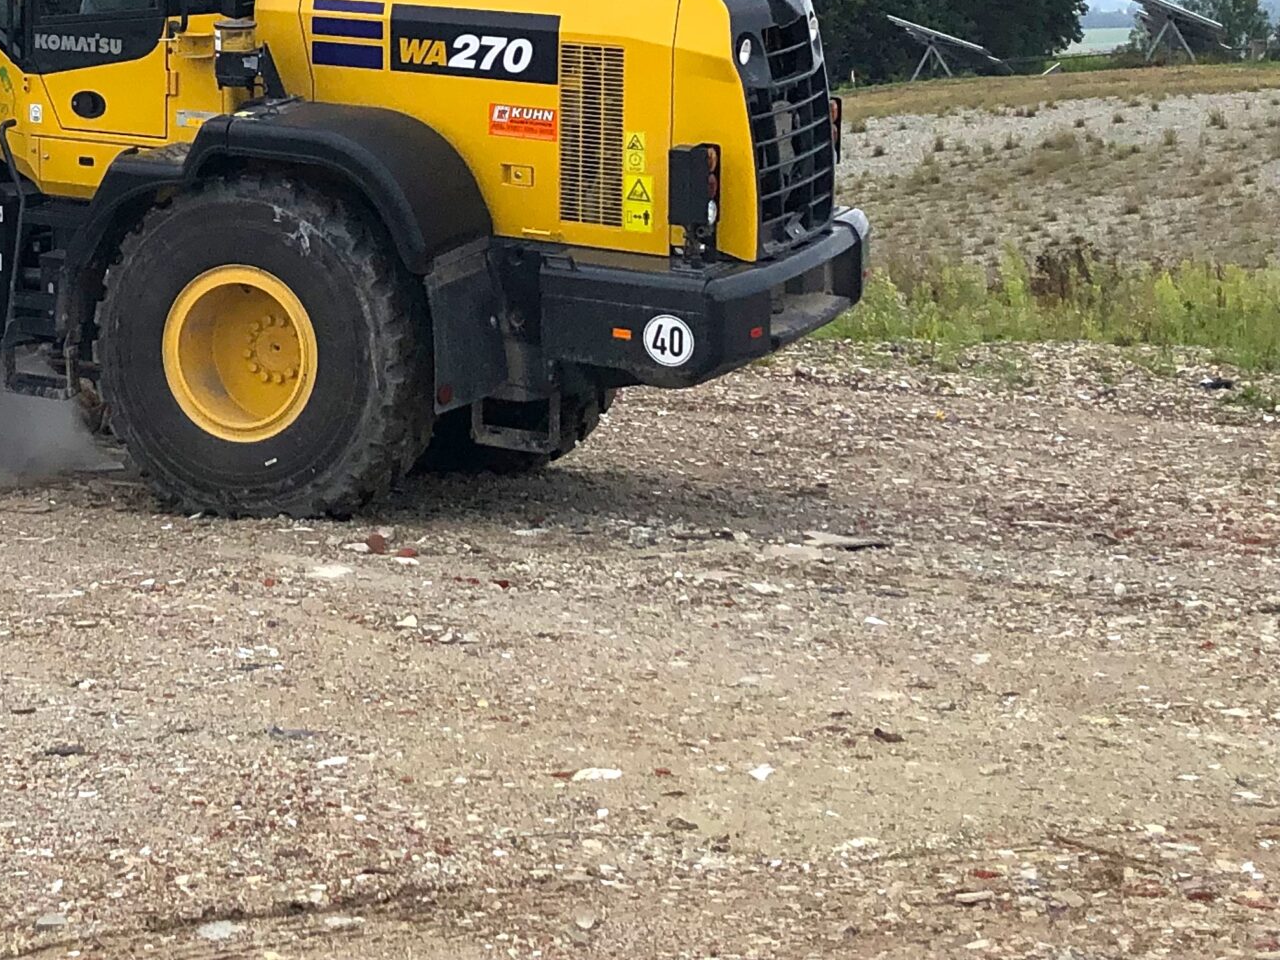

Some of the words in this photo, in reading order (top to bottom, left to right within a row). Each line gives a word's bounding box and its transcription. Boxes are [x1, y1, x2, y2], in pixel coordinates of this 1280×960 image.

[34, 33, 122, 55] KOMATSU
[400, 34, 533, 73] WA270
[511, 107, 553, 121] KUHN
[652, 324, 683, 357] 40
